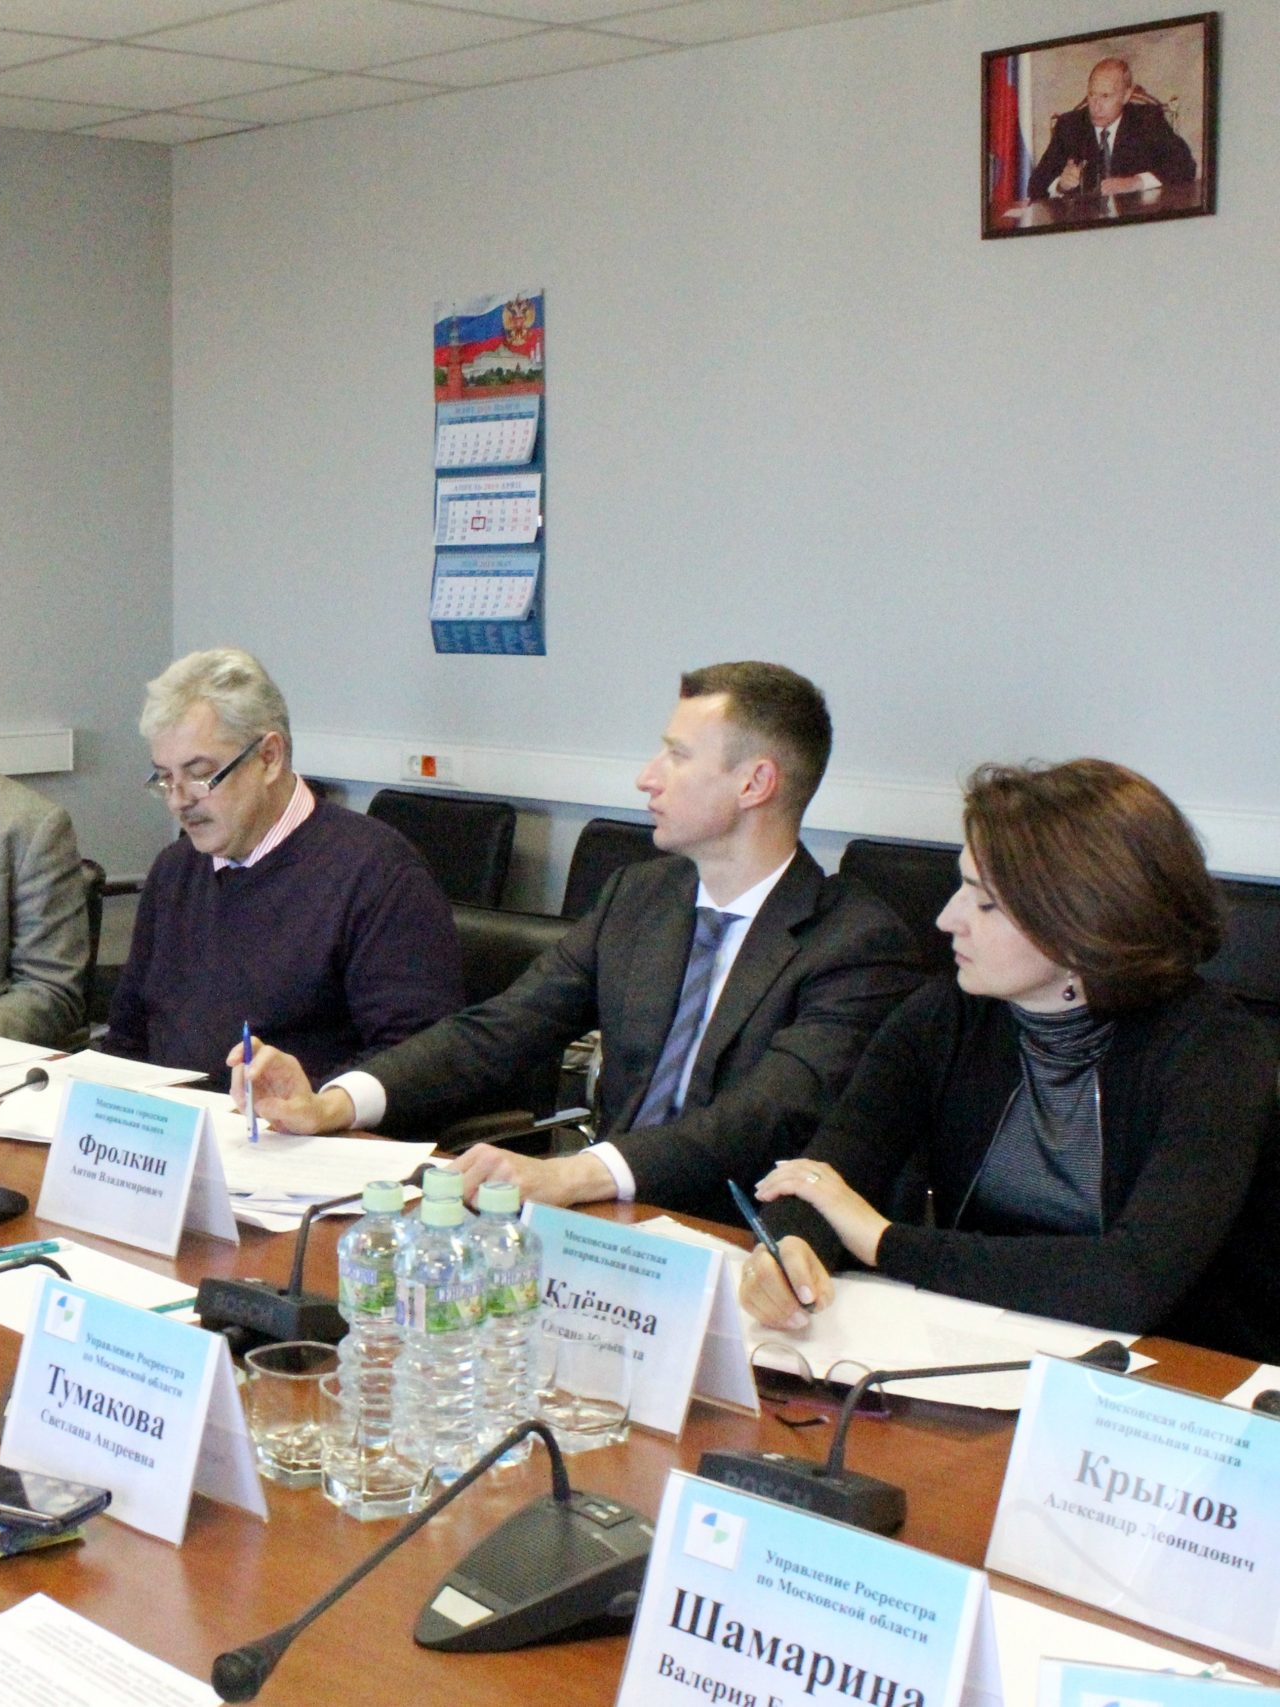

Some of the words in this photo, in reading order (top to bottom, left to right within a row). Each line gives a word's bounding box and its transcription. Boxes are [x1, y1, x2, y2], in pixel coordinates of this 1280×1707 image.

[70, 1164, 96, 1180] Антон
[98, 1171, 163, 1198] Владимирович
[79, 1134, 167, 1176] Фролкин
[562, 1246, 627, 1271] нотариальная
[628, 1263, 661, 1280] палата
[564, 1228, 618, 1252] Московская
[620, 1245, 668, 1265] областная
[82, 1352, 94, 1364] по
[95, 1356, 146, 1384] Московской
[147, 1375, 183, 1398] области
[85, 1332, 135, 1360] Управление
[136, 1351, 186, 1380] Росреестра
[48, 1363, 165, 1440] Тумакова
[1096, 1394, 1177, 1428] Московская
[1178, 1416, 1251, 1450] областная
[40, 1408, 92, 1441] Светлана
[94, 1430, 156, 1469] Андреевна
[1094, 1415, 1190, 1452] нотариальная
[1193, 1445, 1242, 1468] палата
[1074, 1448, 1238, 1531] Крылов
[1042, 1491, 1137, 1535] Александр
[1140, 1522, 1255, 1573] Леонидович
[756, 1573, 774, 1589] по
[777, 1578, 866, 1621] Московской
[868, 1609, 928, 1645] области
[765, 1550, 850, 1591] Управление
[853, 1580, 937, 1624] Росреестра
[668, 1586, 926, 1707] Шамарина
[657, 1652, 757, 1707] Валерия
